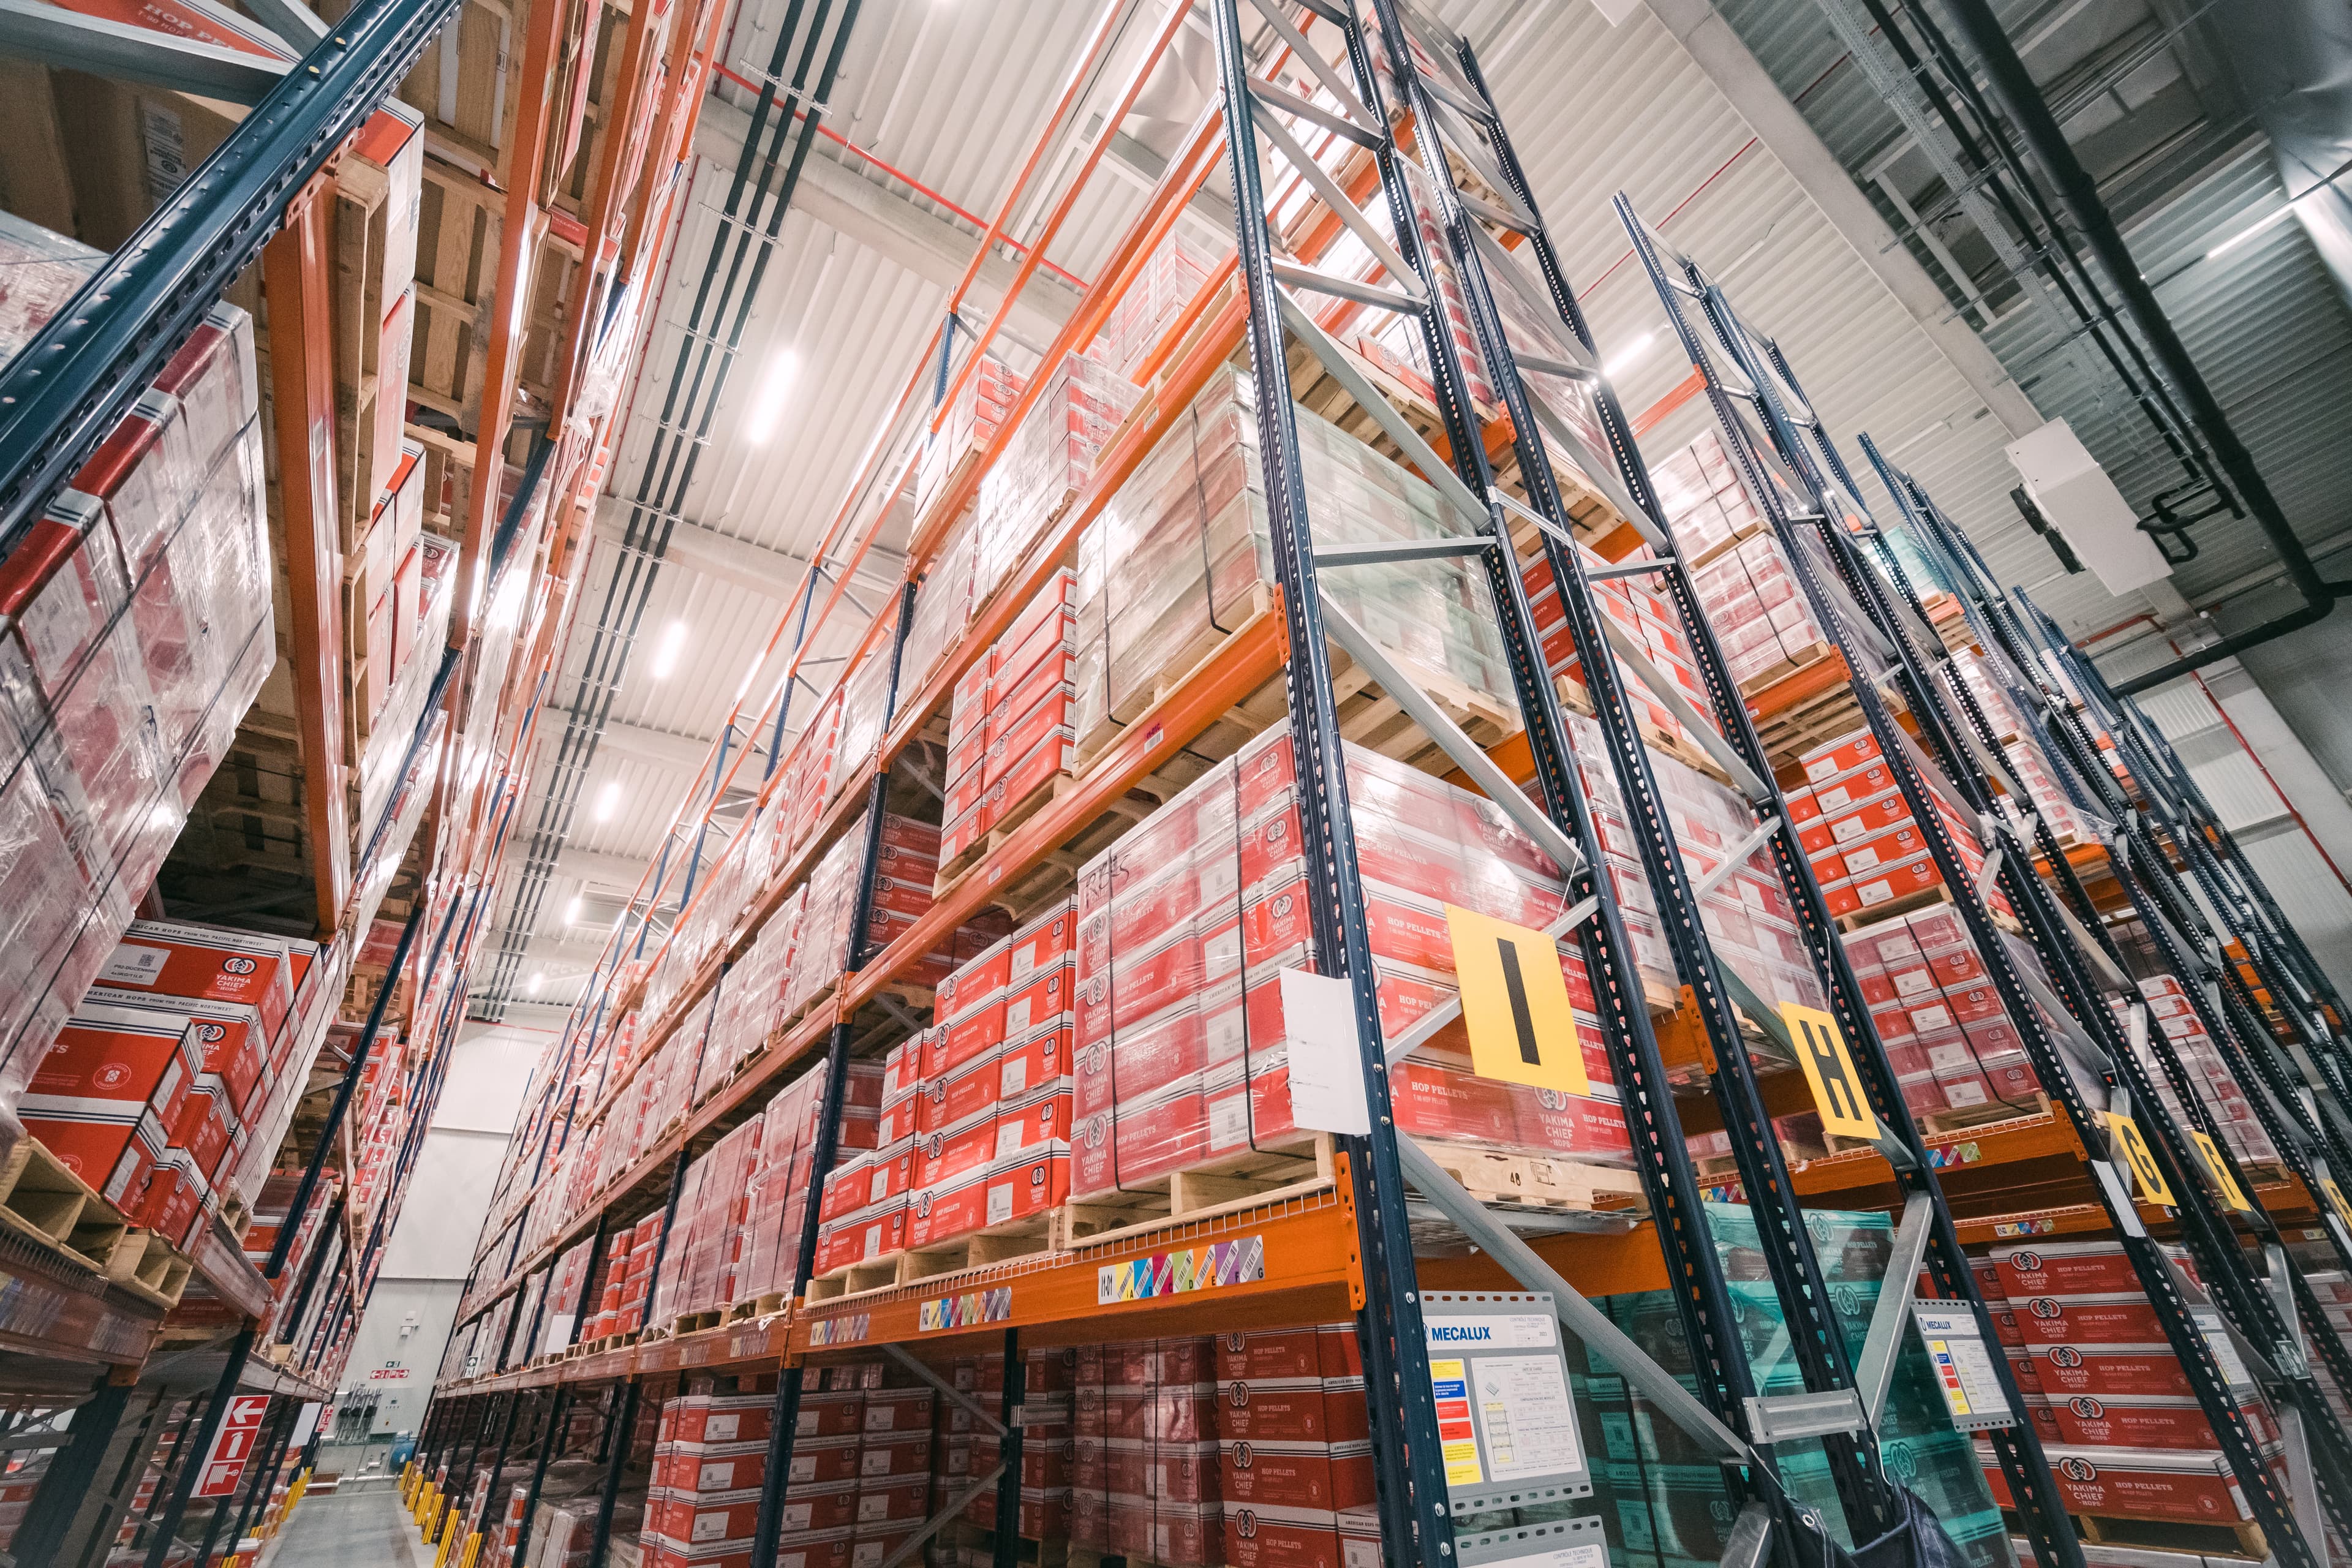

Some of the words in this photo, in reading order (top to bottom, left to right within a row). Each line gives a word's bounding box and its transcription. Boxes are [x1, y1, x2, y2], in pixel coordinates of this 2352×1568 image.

[143, 3, 193, 30] HOP
[1260, 767, 1281, 783] YAKIMA
[1267, 836, 1289, 852] YAKIMA
[1376, 842, 1393, 853] HOP
[1269, 844, 1287, 858] CHIEF
[1117, 920, 1129, 932] HOP
[1273, 914, 1296, 931] YAKIMA
[1387, 916, 1405, 927] HOP
[1406, 922, 1441, 938] PELLETS
[1275, 923, 1294, 937] CHIEF
[216, 974, 251, 984] YAKIMA
[1562, 967, 1589, 981] PELLETS
[1117, 986, 1129, 998] HOP
[1129, 971, 1154, 990] PELLETS
[1399, 994, 1417, 1006] HOP
[1496, 938, 1541, 1066] I
[199, 1003, 231, 1012] NORTHWEST
[1085, 1003, 1109, 1020] YAKIMA
[1087, 1015, 1105, 1030] CHIEF
[1578, 1038, 1606, 1051] PELLETS
[1798, 1020, 1864, 1121] H
[1083, 1076, 1108, 1090] YAKIMA
[1085, 1087, 1105, 1101] CHIEF
[1411, 1082, 1430, 1093] HOP
[1431, 1085, 1468, 1100] PELLETS
[931, 1102, 946, 1115] YAKIMA
[1538, 1112, 1575, 1128] YAKIMA
[1582, 1114, 1597, 1123] HOP
[1598, 1117, 1627, 1129] PELLETS
[1117, 1134, 1128, 1146] HOP
[1129, 1125, 1156, 1142] PELLETS
[1545, 1126, 1574, 1140] CHIEF
[1082, 1149, 1107, 1167] YAKIMA
[2122, 1125, 2162, 1194] G
[1084, 1161, 1104, 1177] CHIEF
[1510, 1172, 1521, 1187] 48
[1030, 1185, 1046, 1195] YAKIMA
[1031, 1193, 1044, 1201] CHIEF
[943, 1202, 960, 1215] PELLETS
[914, 1219, 931, 1231] YAKIMA
[914, 1228, 928, 1240] CHIEF
[1235, 1272, 1239, 1283] F
[1258, 1267, 1264, 1279] G
[1189, 1279, 1194, 1289] D
[1212, 1275, 1216, 1286] E
[1148, 1286, 1153, 1296] B
[1169, 1283, 1173, 1292] C
[1130, 1290, 1134, 1299] A
[1843, 1321, 1869, 1330] YAKIMA
[1926, 1321, 1951, 1329] MECALUX
[1431, 1327, 1491, 1341] MECALUX
[1226, 1354, 1248, 1363] YAKIMA
[1229, 1362, 1246, 1371] CHIEF
[1232, 1471, 1255, 1480] YAKIMA
[1235, 1481, 1253, 1490] CHIEF
[2065, 1483, 2106, 1494] YAKIMA
[2135, 1482, 2173, 1491] PELLETS
[2073, 1492, 2105, 1501] CHIEF
[1236, 1540, 1259, 1551] YAKIMA
[1278, 1540, 1302, 1549] PELLETS
[1238, 1550, 1257, 1559] CHIEF
